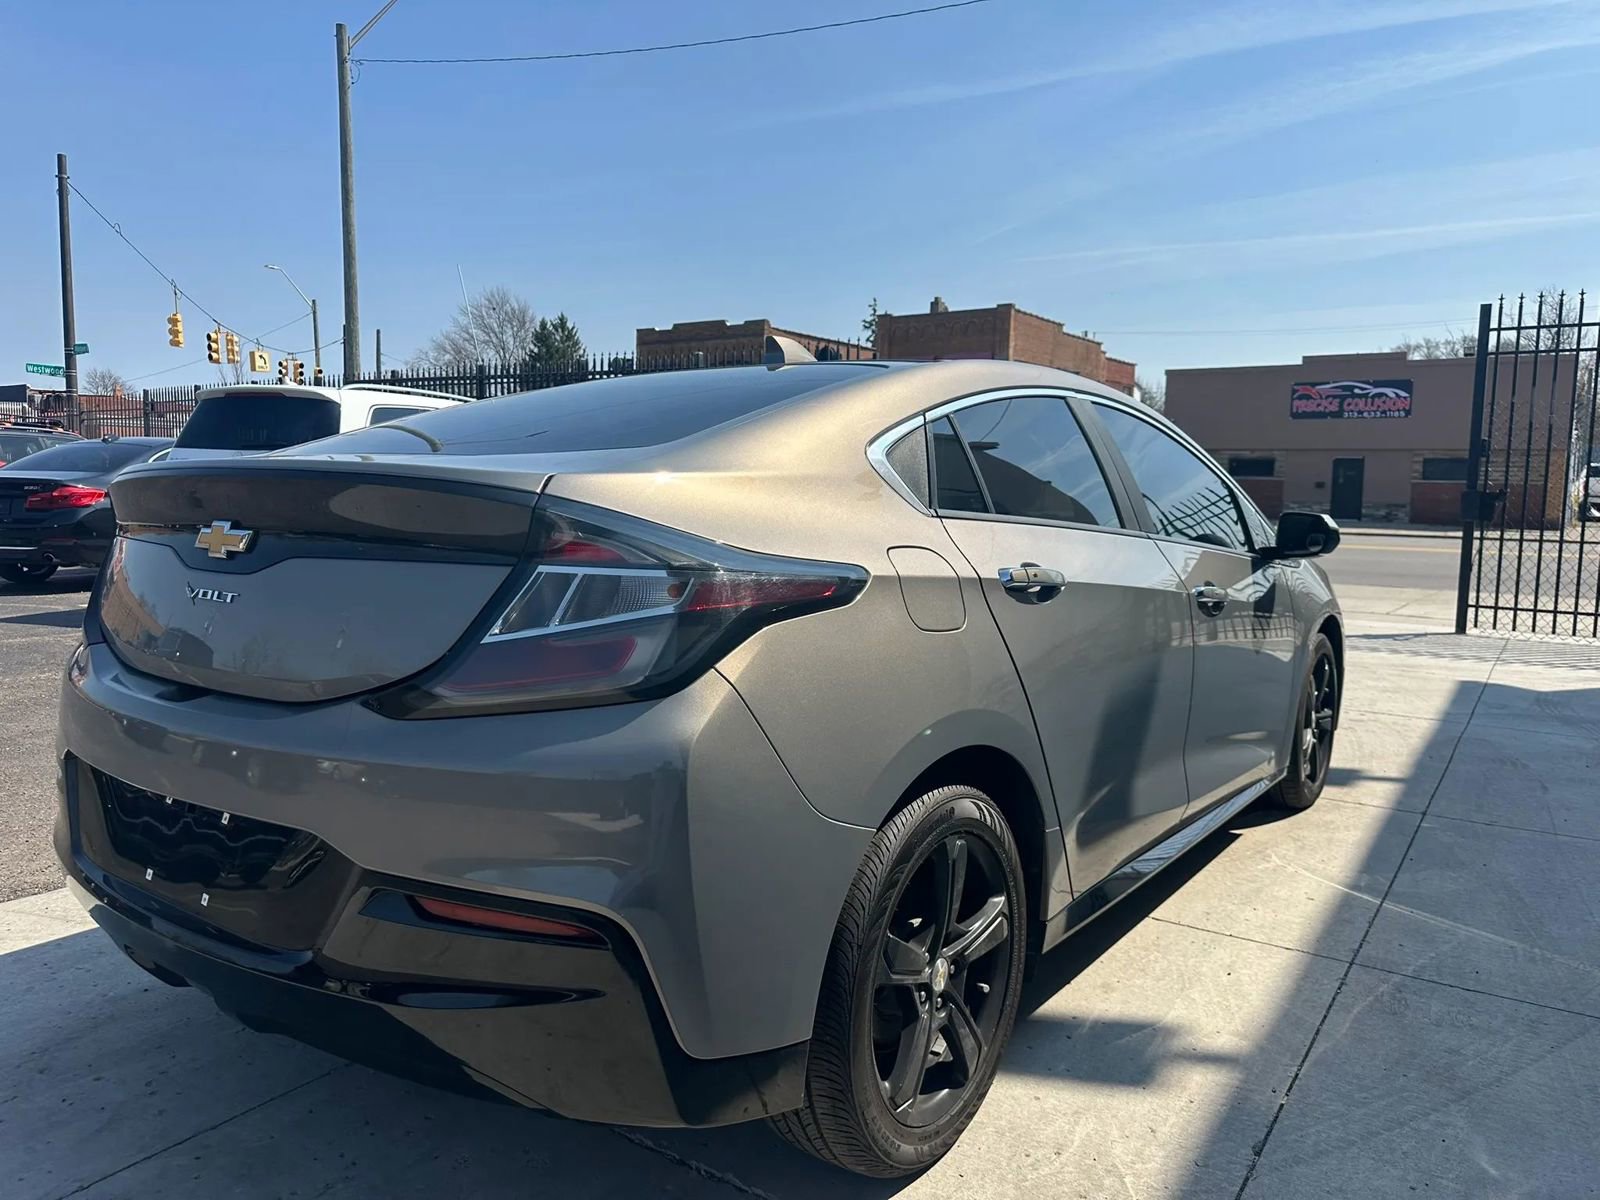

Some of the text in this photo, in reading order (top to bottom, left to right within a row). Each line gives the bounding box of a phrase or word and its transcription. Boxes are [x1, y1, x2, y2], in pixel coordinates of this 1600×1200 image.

[26, 364, 64, 375] Westwood
[1344, 396, 1410, 411] COLLISION
[186, 582, 240, 606] VOLT
